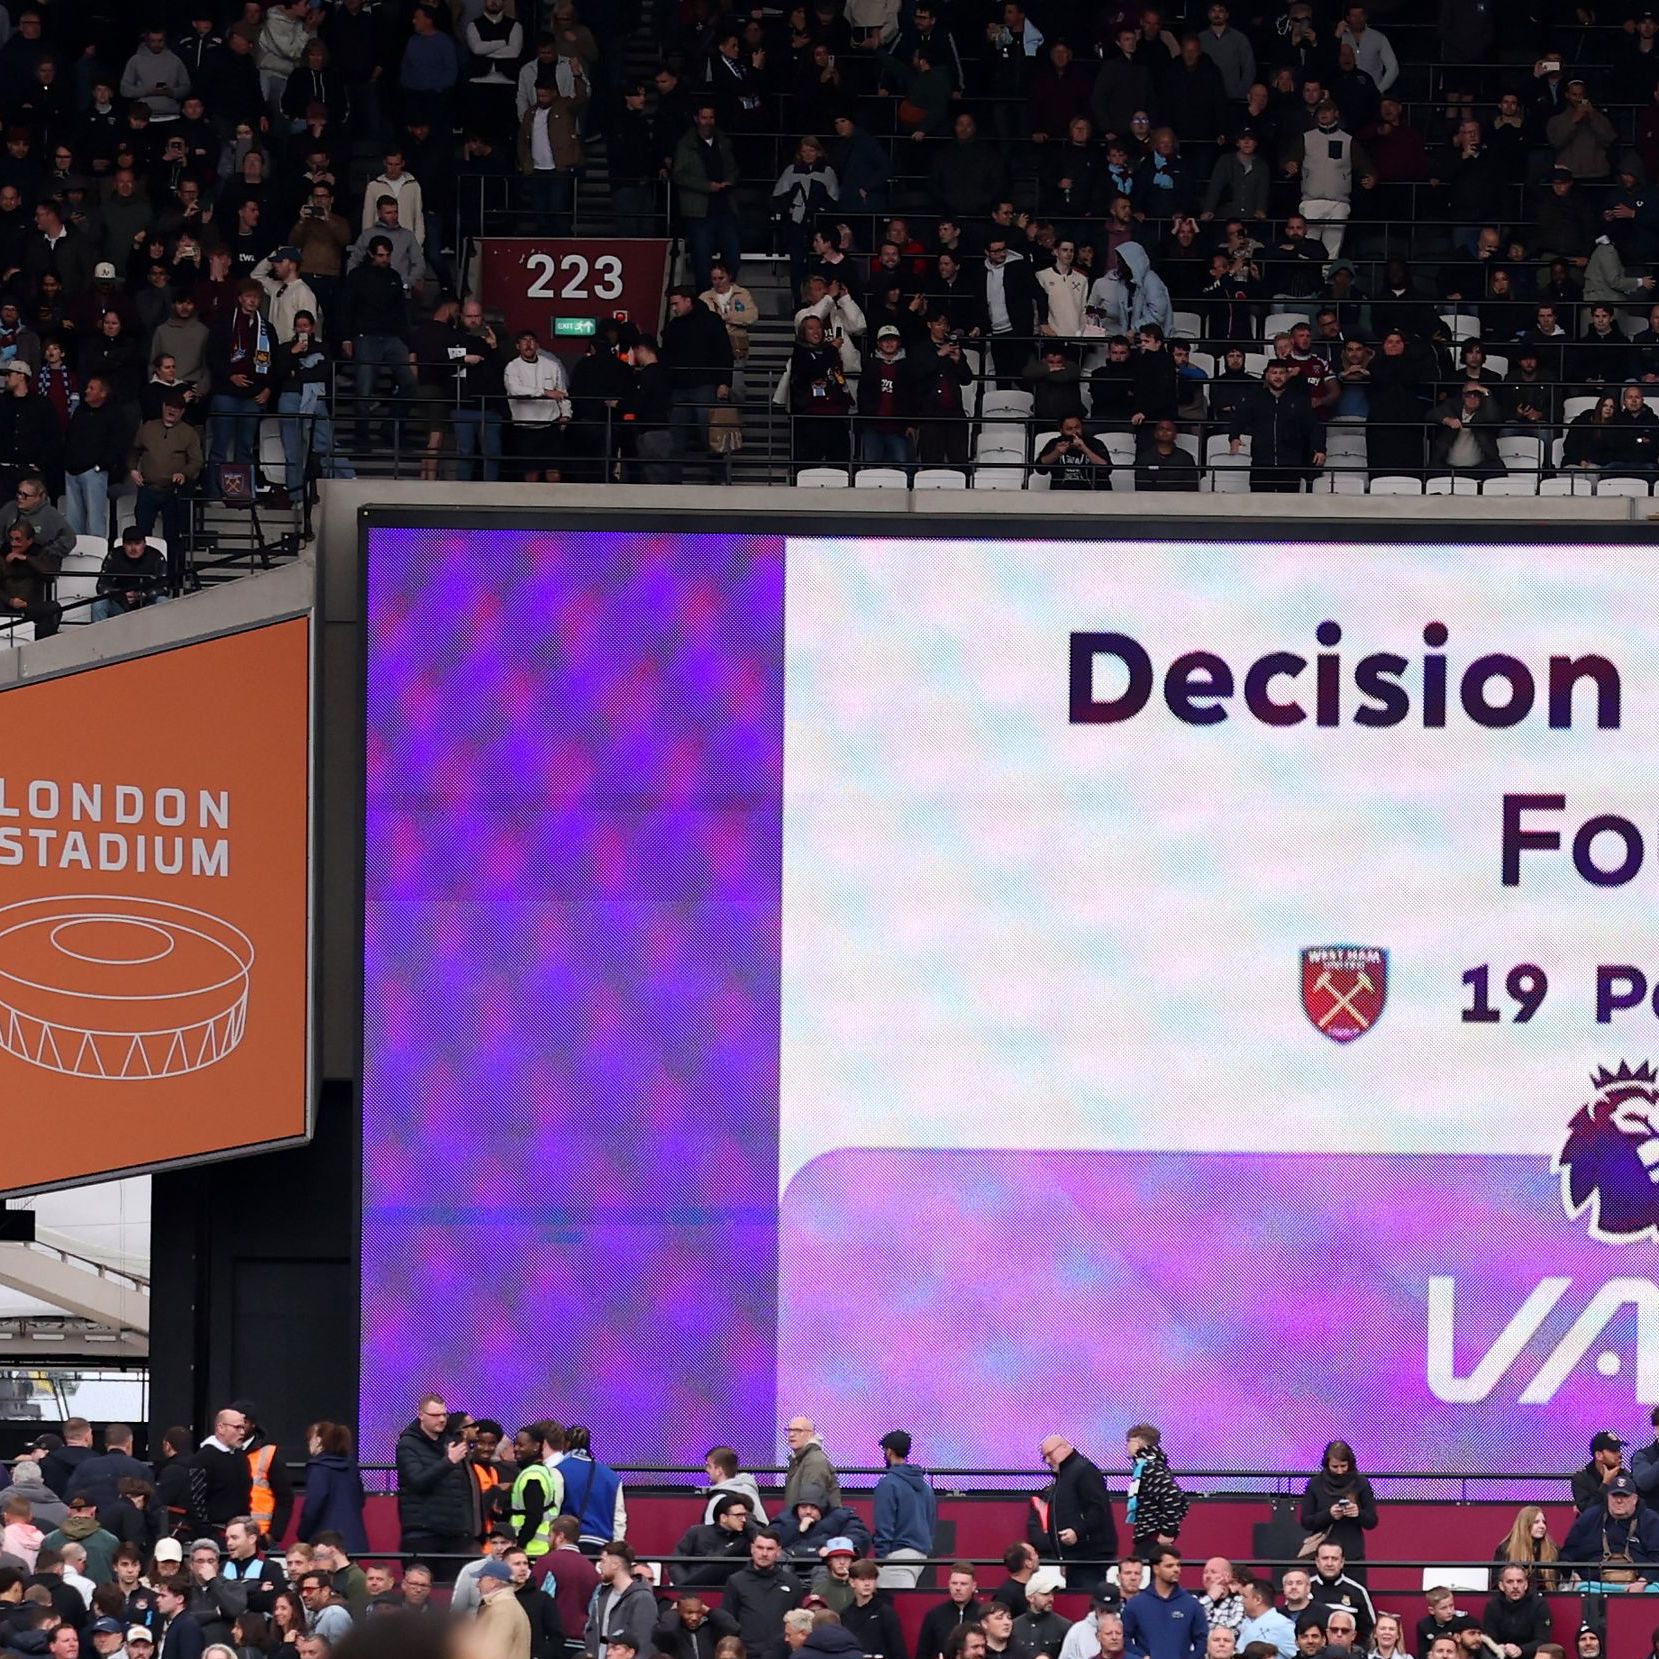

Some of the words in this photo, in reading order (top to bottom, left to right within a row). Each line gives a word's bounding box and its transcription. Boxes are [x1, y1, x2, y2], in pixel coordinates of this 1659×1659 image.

[526, 253, 624, 300] 223
[1068, 620, 1623, 730] Decision
[0, 778, 229, 829] LONDON
[0, 827, 229, 877] STADIUM
[1461, 963, 1549, 1025] 19
